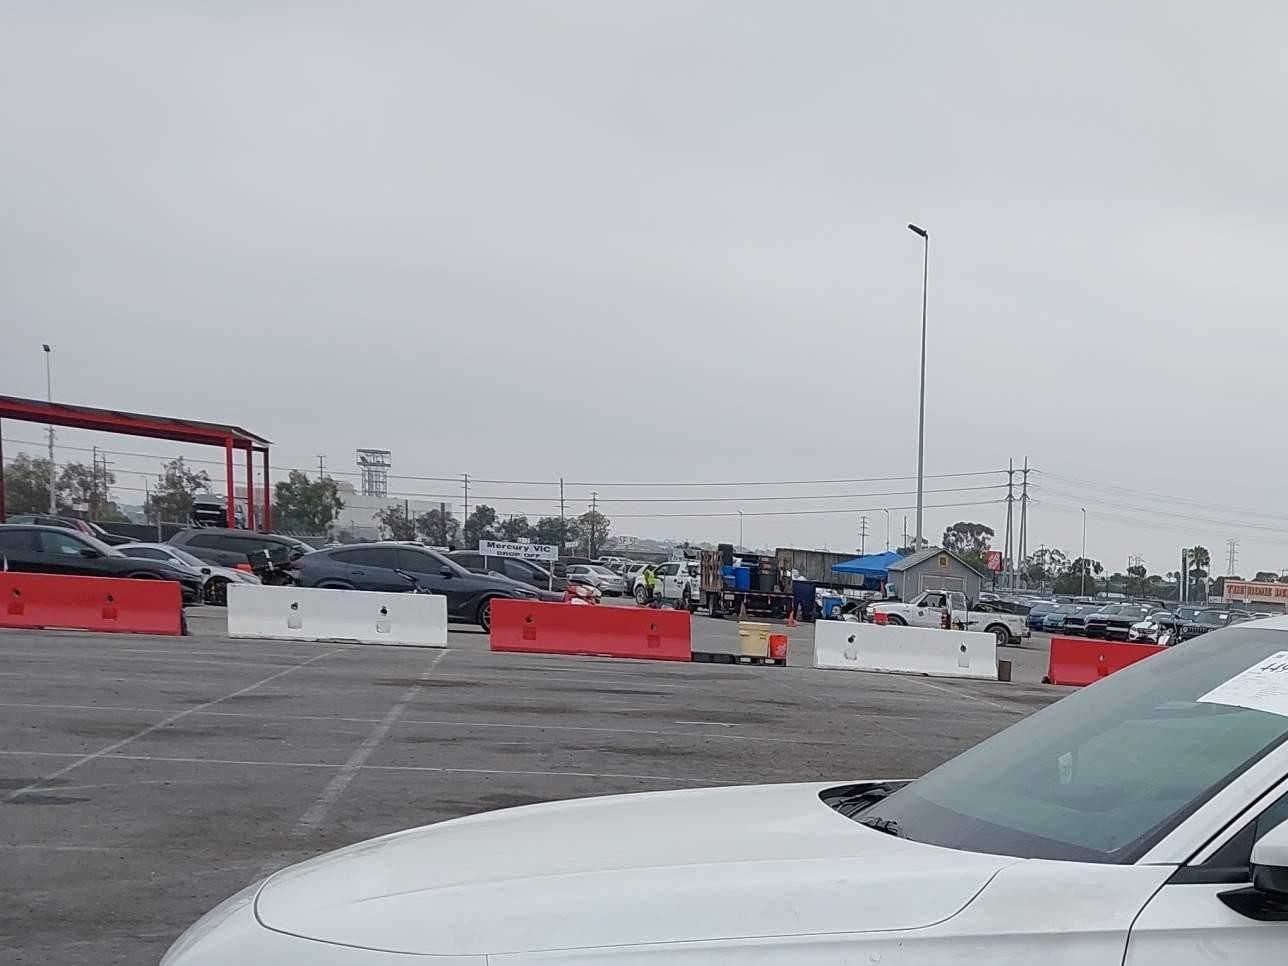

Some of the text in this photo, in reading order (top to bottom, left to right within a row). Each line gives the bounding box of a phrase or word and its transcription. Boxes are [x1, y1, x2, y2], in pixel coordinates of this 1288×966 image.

[487, 542, 551, 553] Mercury VIC
[1227, 585, 1244, 594] THE
[1247, 586, 1273, 597] HOME
